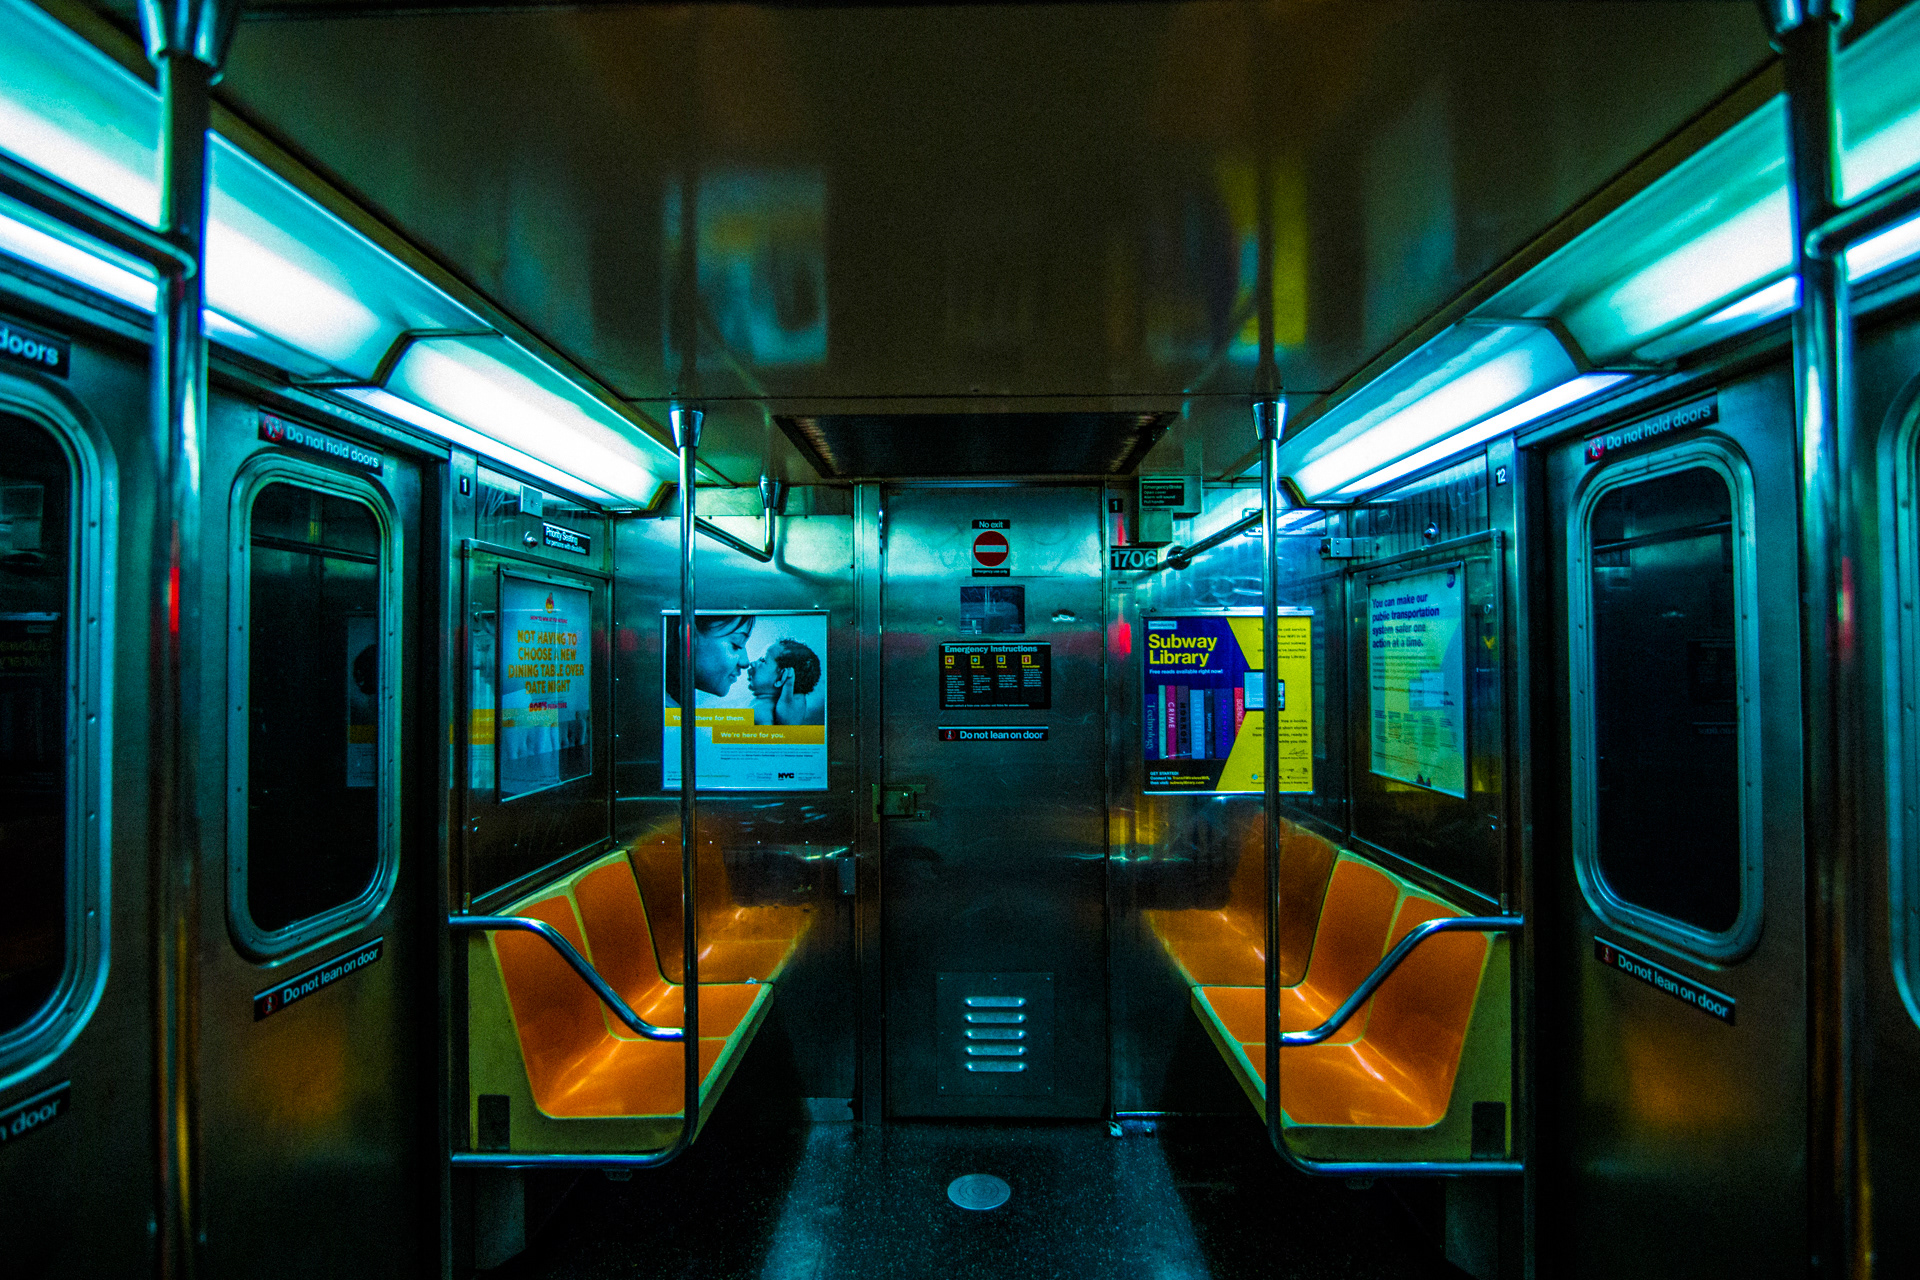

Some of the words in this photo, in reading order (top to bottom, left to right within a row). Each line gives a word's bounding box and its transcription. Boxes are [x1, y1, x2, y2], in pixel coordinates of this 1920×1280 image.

[1606, 436, 1621, 450] Do
[1623, 428, 1642, 445] not
[1644, 415, 1670, 437] hold
[1672, 404, 1711, 428] doors
[286, 426, 304, 444] Do
[305, 435, 324, 451] not
[326, 439, 349, 459] hold
[351, 449, 379, 469] doors
[1496, 468, 1506, 484] 12
[463, 478, 468, 493] 1
[1112, 500, 1118, 511] 1
[546, 526, 562, 541] Priority
[562, 531, 578, 546] Seating
[1111, 550, 1157, 568] 1706
[1372, 598, 1383, 609] You
[1384, 598, 1395, 607] can
[1397, 594, 1415, 605] make
[1416, 594, 1428, 603] our
[1372, 610, 1390, 623] public
[1391, 606, 1440, 621] transportation
[517, 629, 536, 643] NOT
[537, 631, 566, 645] HAVING
[567, 633, 577, 645] TO
[1372, 625, 1393, 637] system
[1395, 622, 1412, 633] safer
[1413, 623, 1426, 632] one
[944, 645, 989, 654] Emergency
[990, 645, 1038, 653] Instructions
[1148, 633, 1218, 651] Subway
[1372, 638, 1391, 648] action
[1392, 638, 1399, 647] at
[1400, 639, 1405, 647] a
[518, 647, 552, 661] CHOOSE
[554, 650, 560, 661] A
[560, 648, 577, 661] NEW
[1149, 649, 1210, 667] Library
[508, 664, 539, 678] DINING
[540, 663, 564, 677] TABLE
[565, 663, 585, 677] OVER
[525, 680, 546, 694] DATE
[547, 679, 570, 693] NIGHT
[1167, 701, 1176, 728] CRIME
[1179, 702, 1187, 744] HORROR
[959, 730, 973, 739] Do
[973, 730, 989, 739] not
[990, 730, 1009, 739] lean
[1022, 730, 1044, 739] door
[1145, 702, 1156, 750] Technology
[283, 986, 300, 1004] Do
[301, 976, 319, 995] not
[321, 966, 342, 985] lean
[344, 961, 356, 974] on
[357, 948, 379, 966] door
[1617, 953, 1633, 972] Do
[1633, 964, 1652, 983] not
[1654, 971, 1679, 995] lean
[1679, 987, 1696, 1004] on
[1697, 992, 1729, 1018] door
[11, 1098, 61, 1136] door
